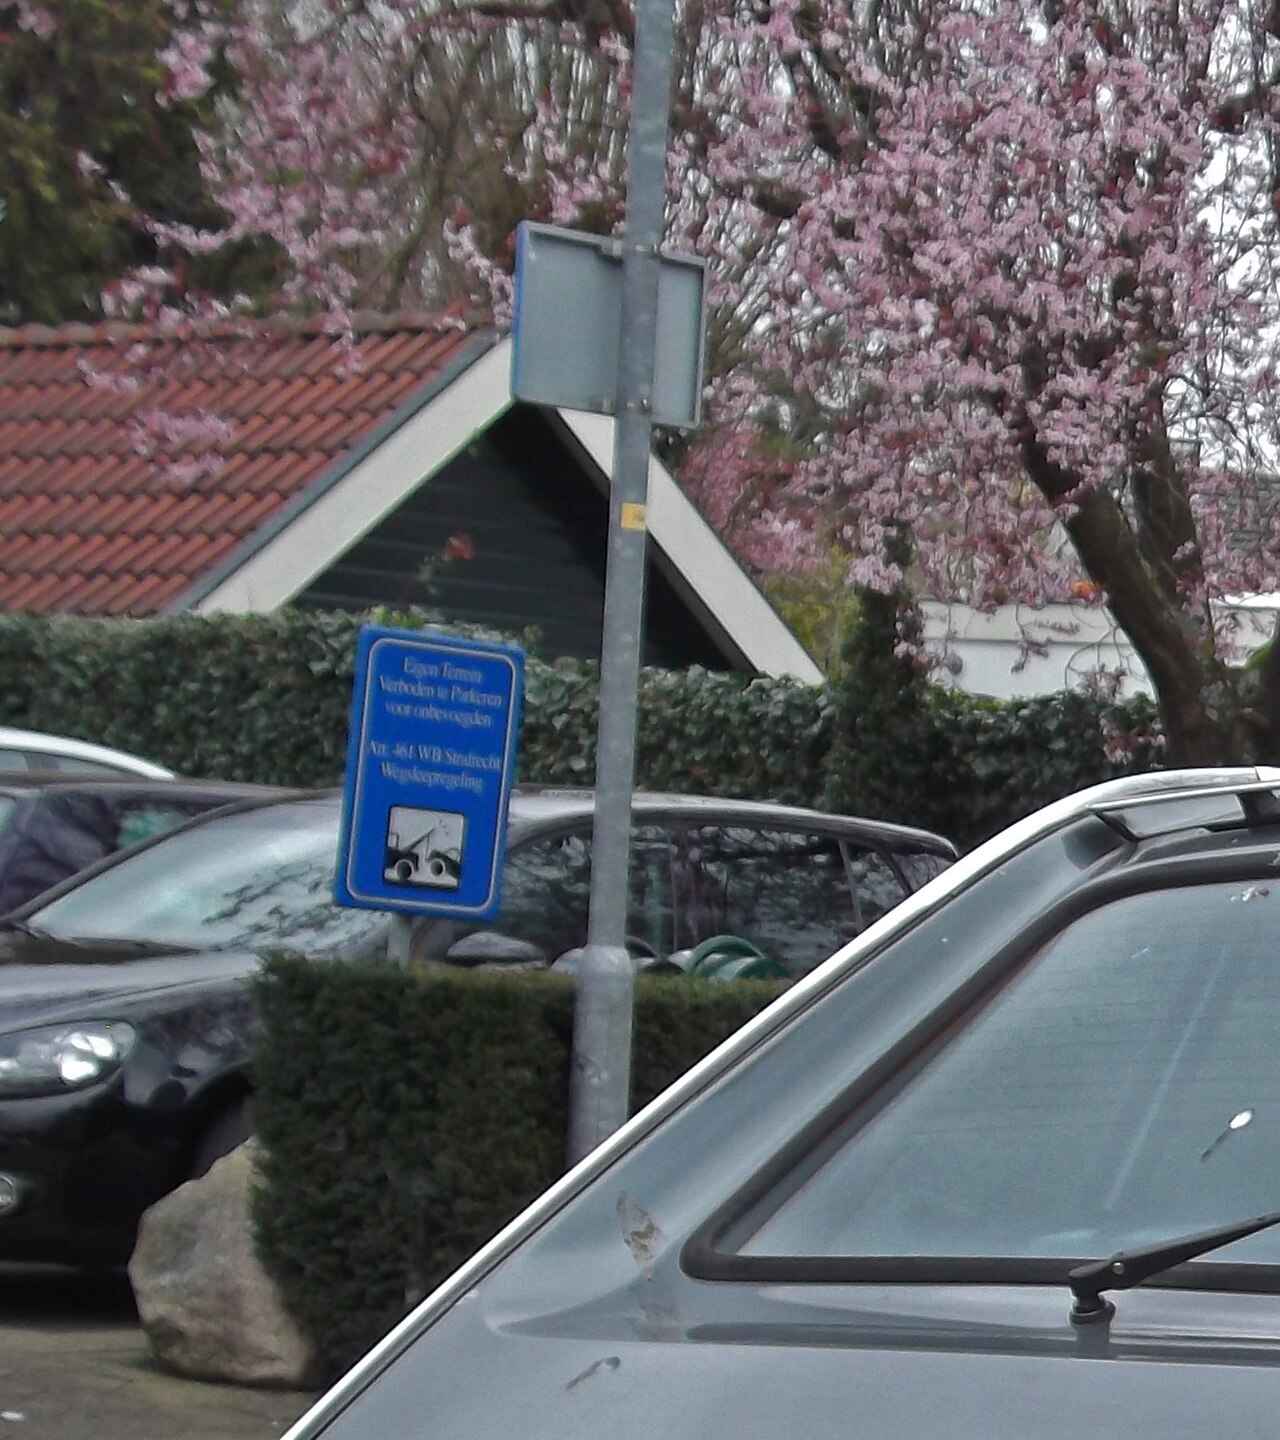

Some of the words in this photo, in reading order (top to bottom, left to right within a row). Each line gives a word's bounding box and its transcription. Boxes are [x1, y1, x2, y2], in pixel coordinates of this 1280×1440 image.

[403, 656, 439, 679] Eigen
[442, 662, 482, 683] Terrein
[380, 674, 435, 698] Verboden
[437, 686, 450, 700] te
[450, 684, 502, 708] Parkeren
[385, 701, 413, 716] voor
[413, 703, 492, 729] onbevoegden
[381, 760, 482, 793] Wegsleepregeling
